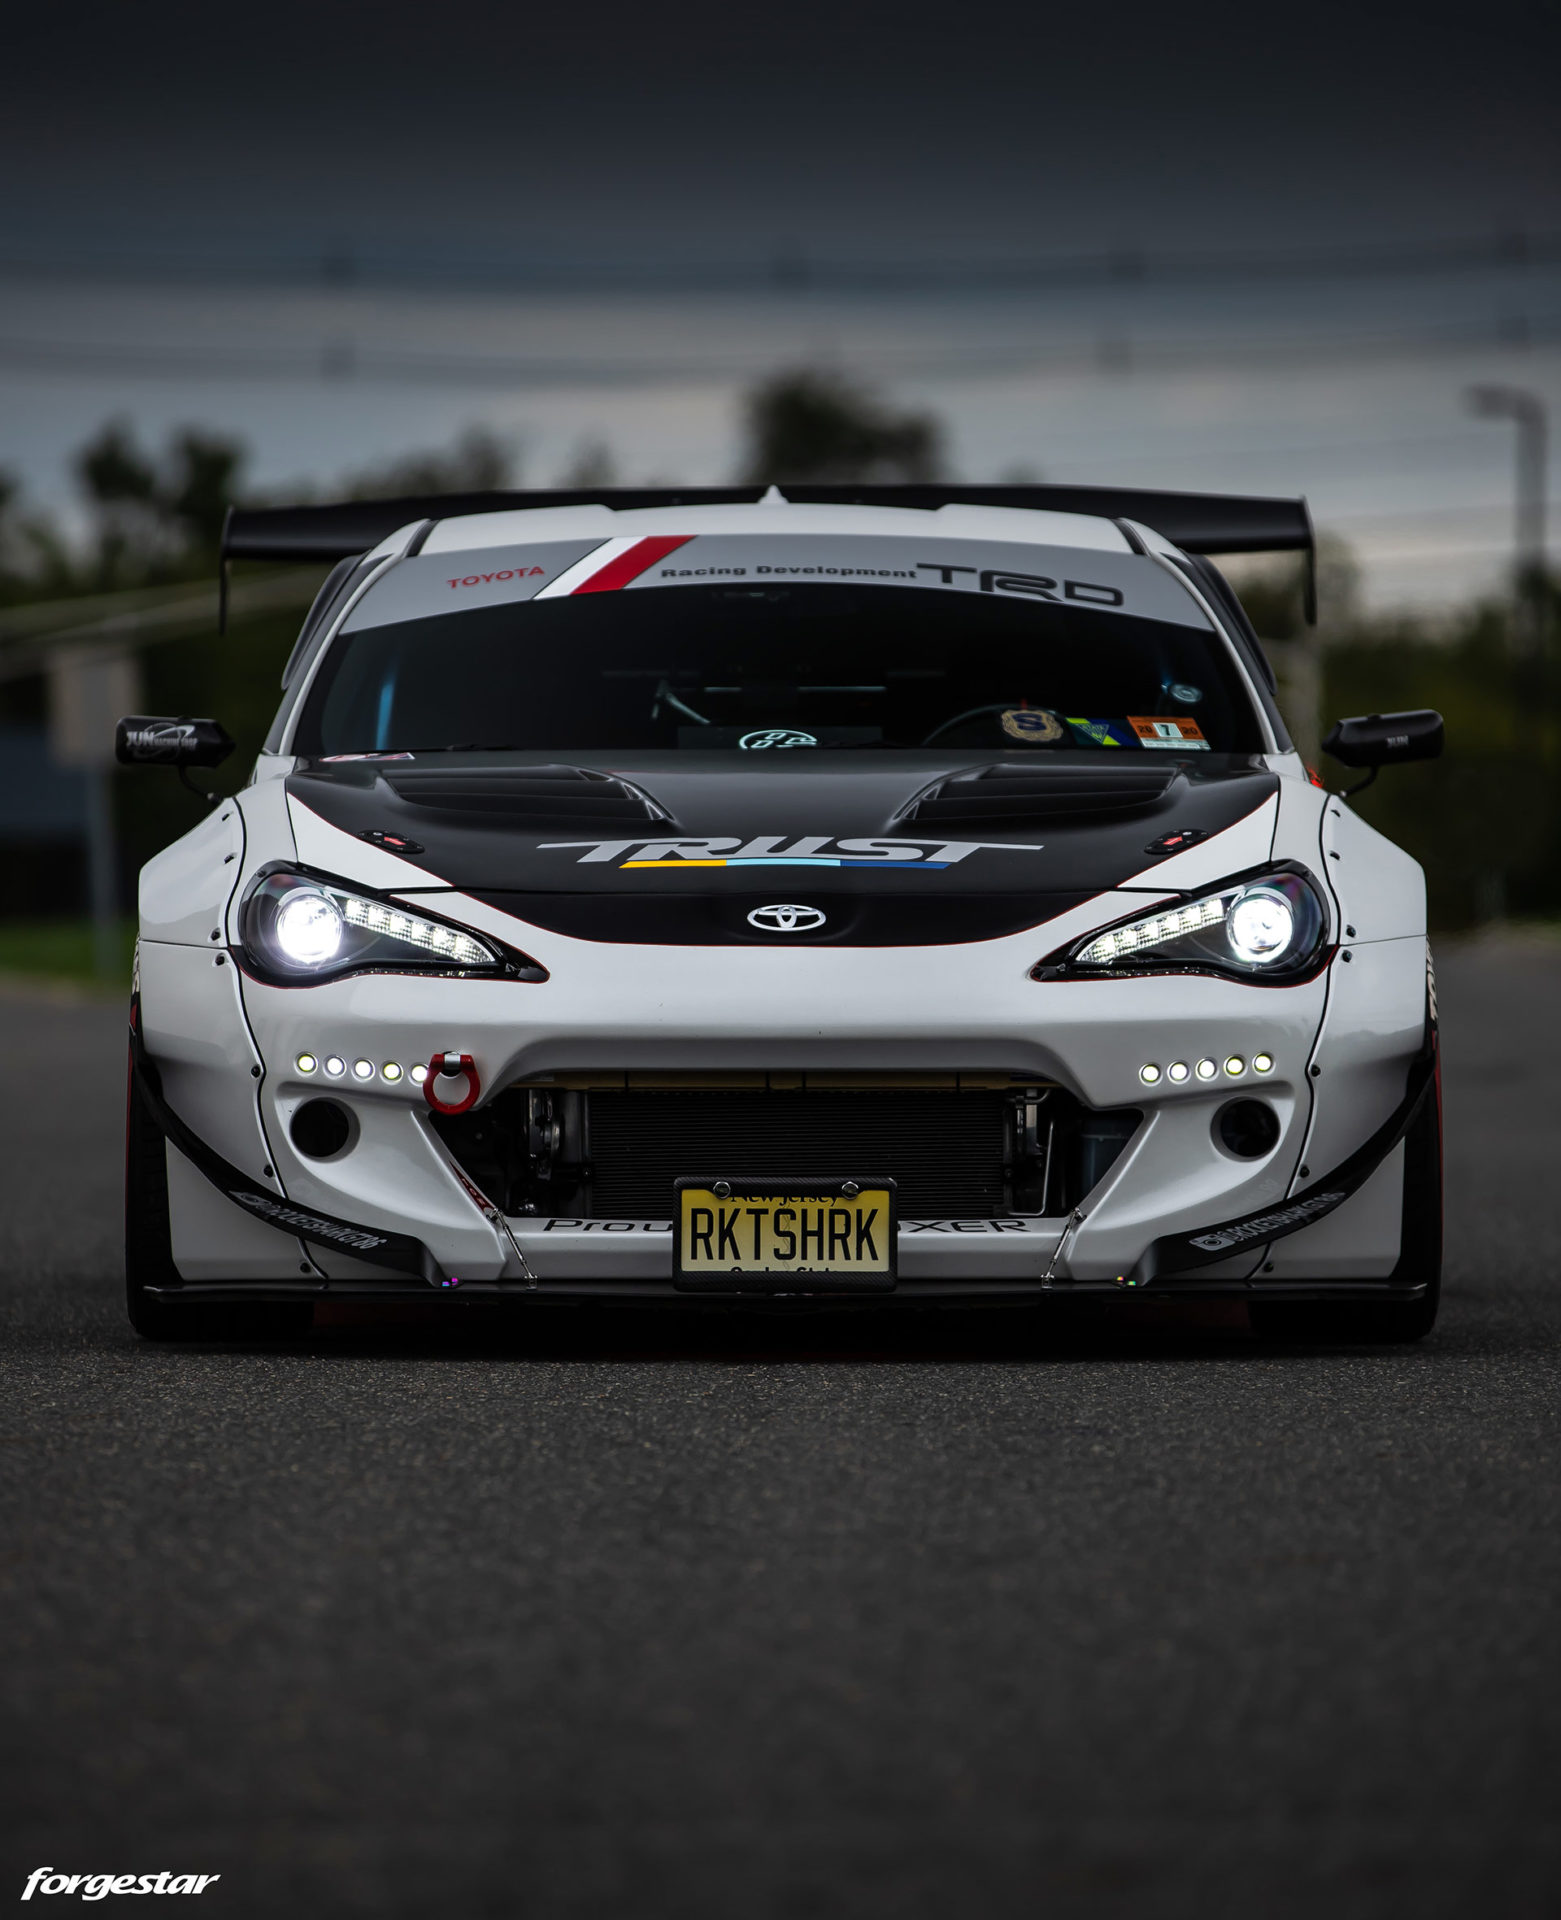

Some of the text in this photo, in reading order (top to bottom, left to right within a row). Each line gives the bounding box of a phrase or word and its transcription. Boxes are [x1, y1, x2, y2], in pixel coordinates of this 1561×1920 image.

[447, 566, 545, 589] TOYOTA
[661, 564, 917, 579] Racing Development
[917, 562, 1124, 606] TRD
[1161, 724, 1171, 736] 7
[536, 836, 1044, 863] TRUST
[543, 1219, 1032, 1233] Prou XER
[691, 1208, 879, 1261] RKTSHRK
